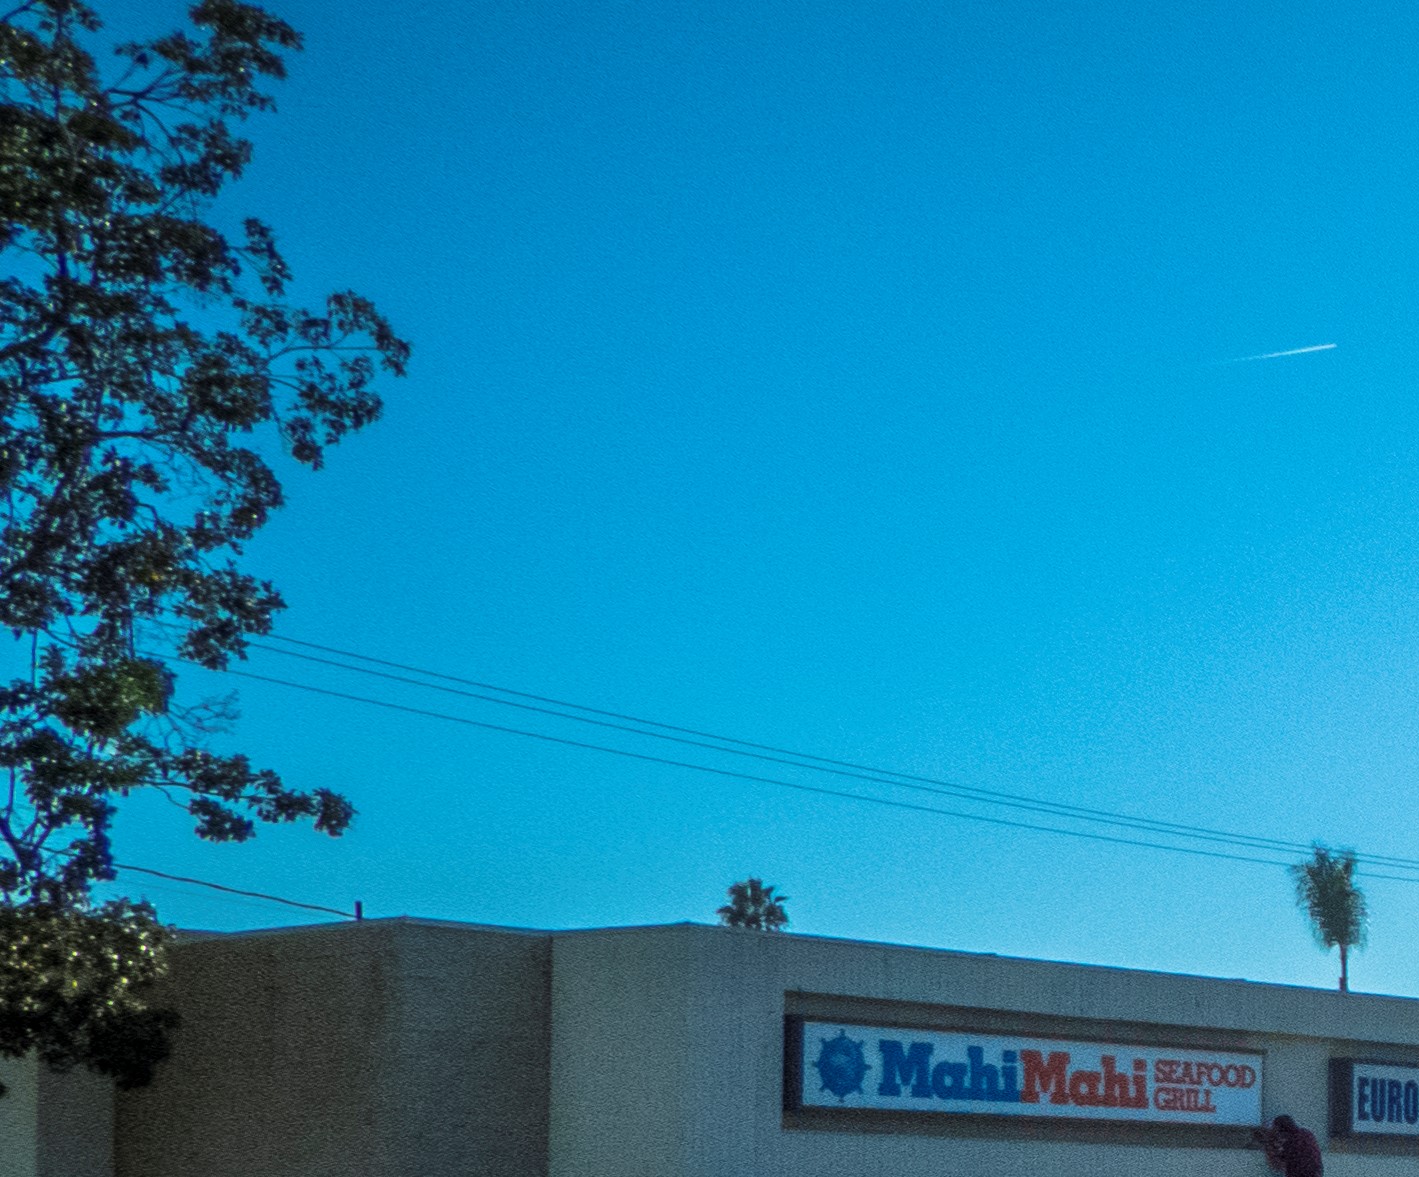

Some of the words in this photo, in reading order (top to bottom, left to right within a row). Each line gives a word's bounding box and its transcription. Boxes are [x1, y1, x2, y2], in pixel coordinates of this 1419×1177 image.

[1153, 1058, 1257, 1090] SEAFOOD
[1153, 1086, 1217, 1113] GRILL
[1357, 1076, 1419, 1125] EURO
